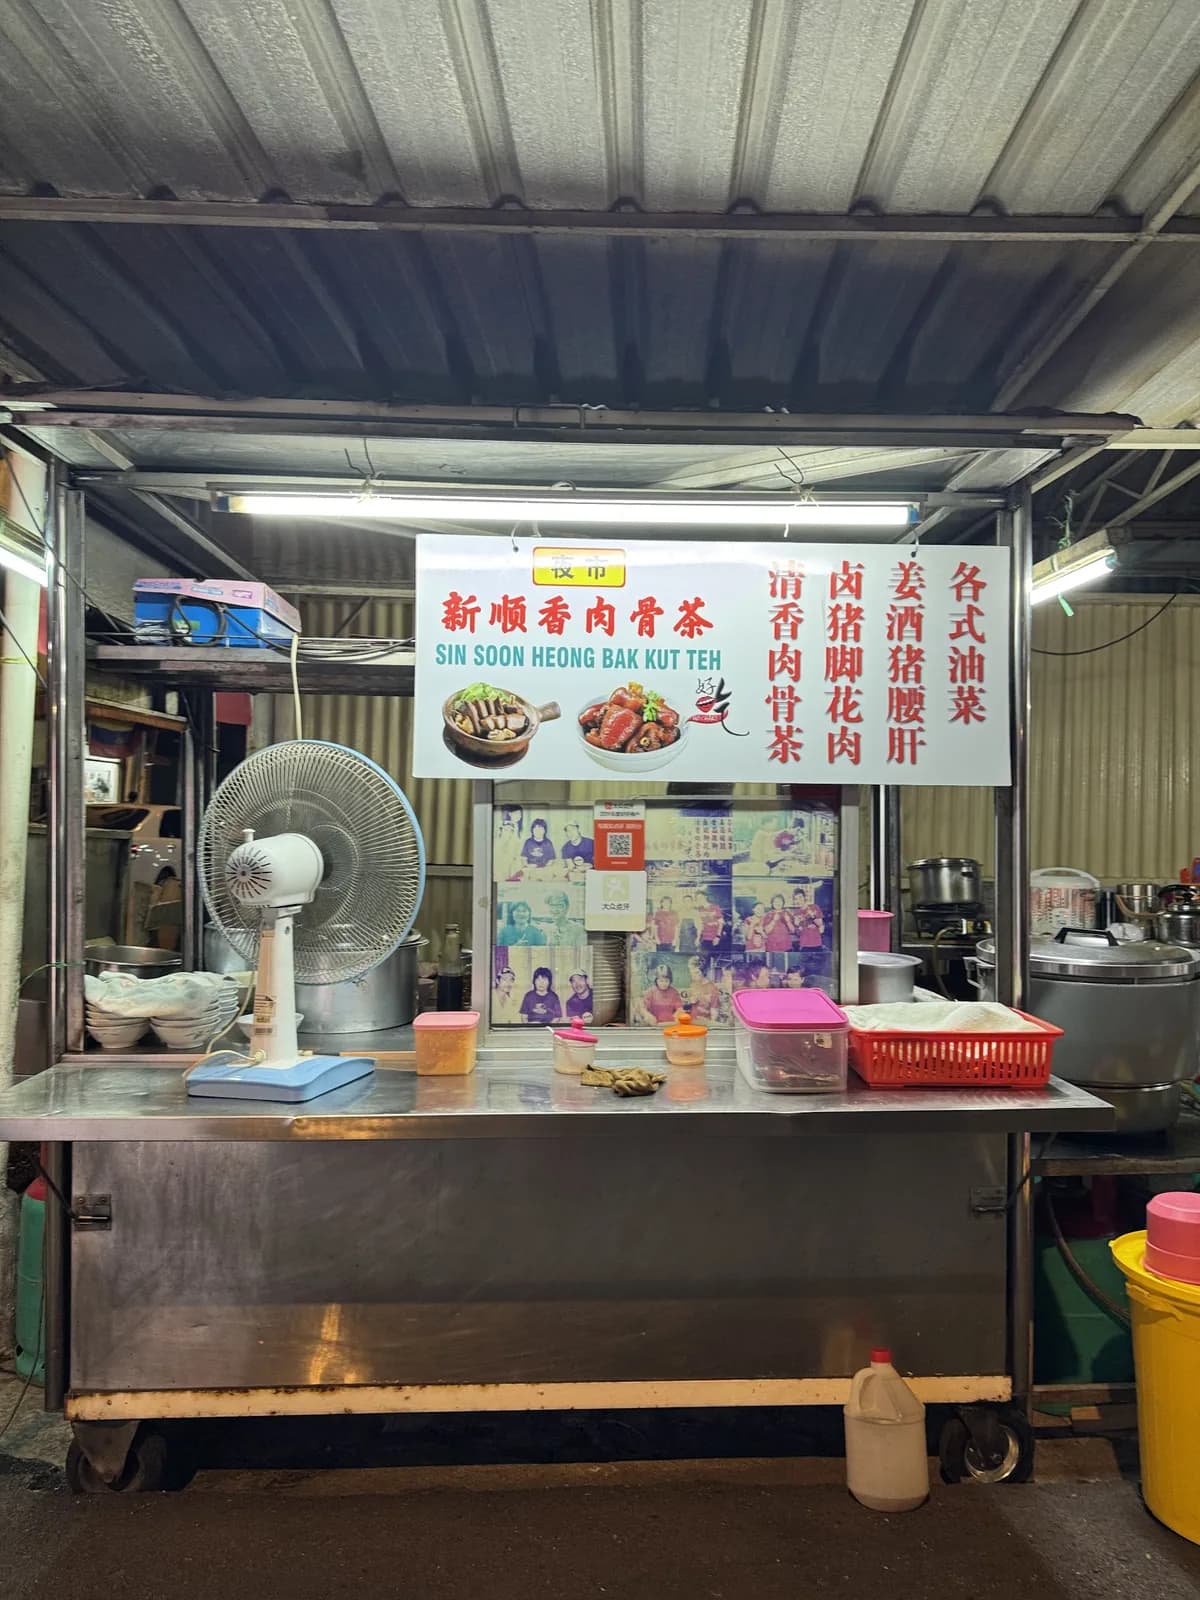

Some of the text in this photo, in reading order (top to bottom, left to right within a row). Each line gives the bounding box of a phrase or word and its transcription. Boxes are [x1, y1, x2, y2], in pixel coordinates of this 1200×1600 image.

[441, 591, 714, 639] 新顺香肉骨茶
[551, 554, 609, 580] 夜市
[948, 562, 988, 724] 各式油菜
[435, 642, 722, 671] SIN SOON HEONG BAK KUT TEH
[765, 560, 805, 764] 清香肉骨茶
[824, 561, 865, 765] 卤猪脚花肉
[886, 561, 927, 764] 姜酒猪腰肝
